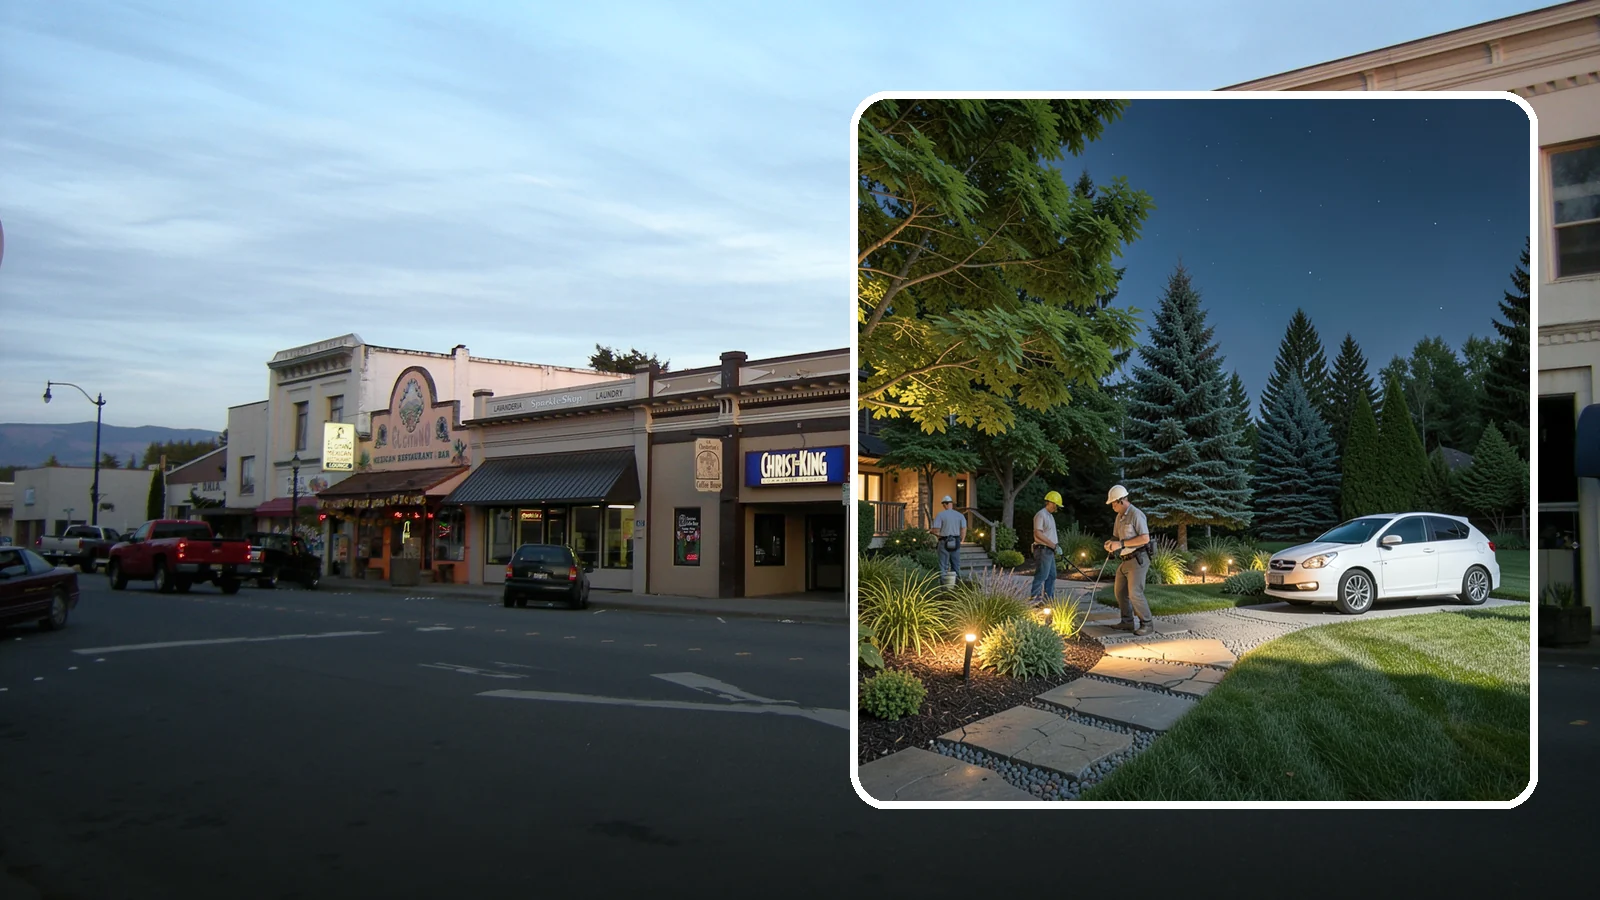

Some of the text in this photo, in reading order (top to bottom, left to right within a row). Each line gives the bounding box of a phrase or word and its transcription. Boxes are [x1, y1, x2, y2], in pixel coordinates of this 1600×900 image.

[595, 389, 624, 400] LAUNDRY
[493, 402, 523, 413] LAVANDERIA
[373, 455, 396, 464] MEXICAN
[397, 451, 434, 462] RESTAURANT
[437, 450, 450, 459] BAR
[761, 450, 827, 477] CHRIST KING
[696, 480, 709, 489] Coffee
